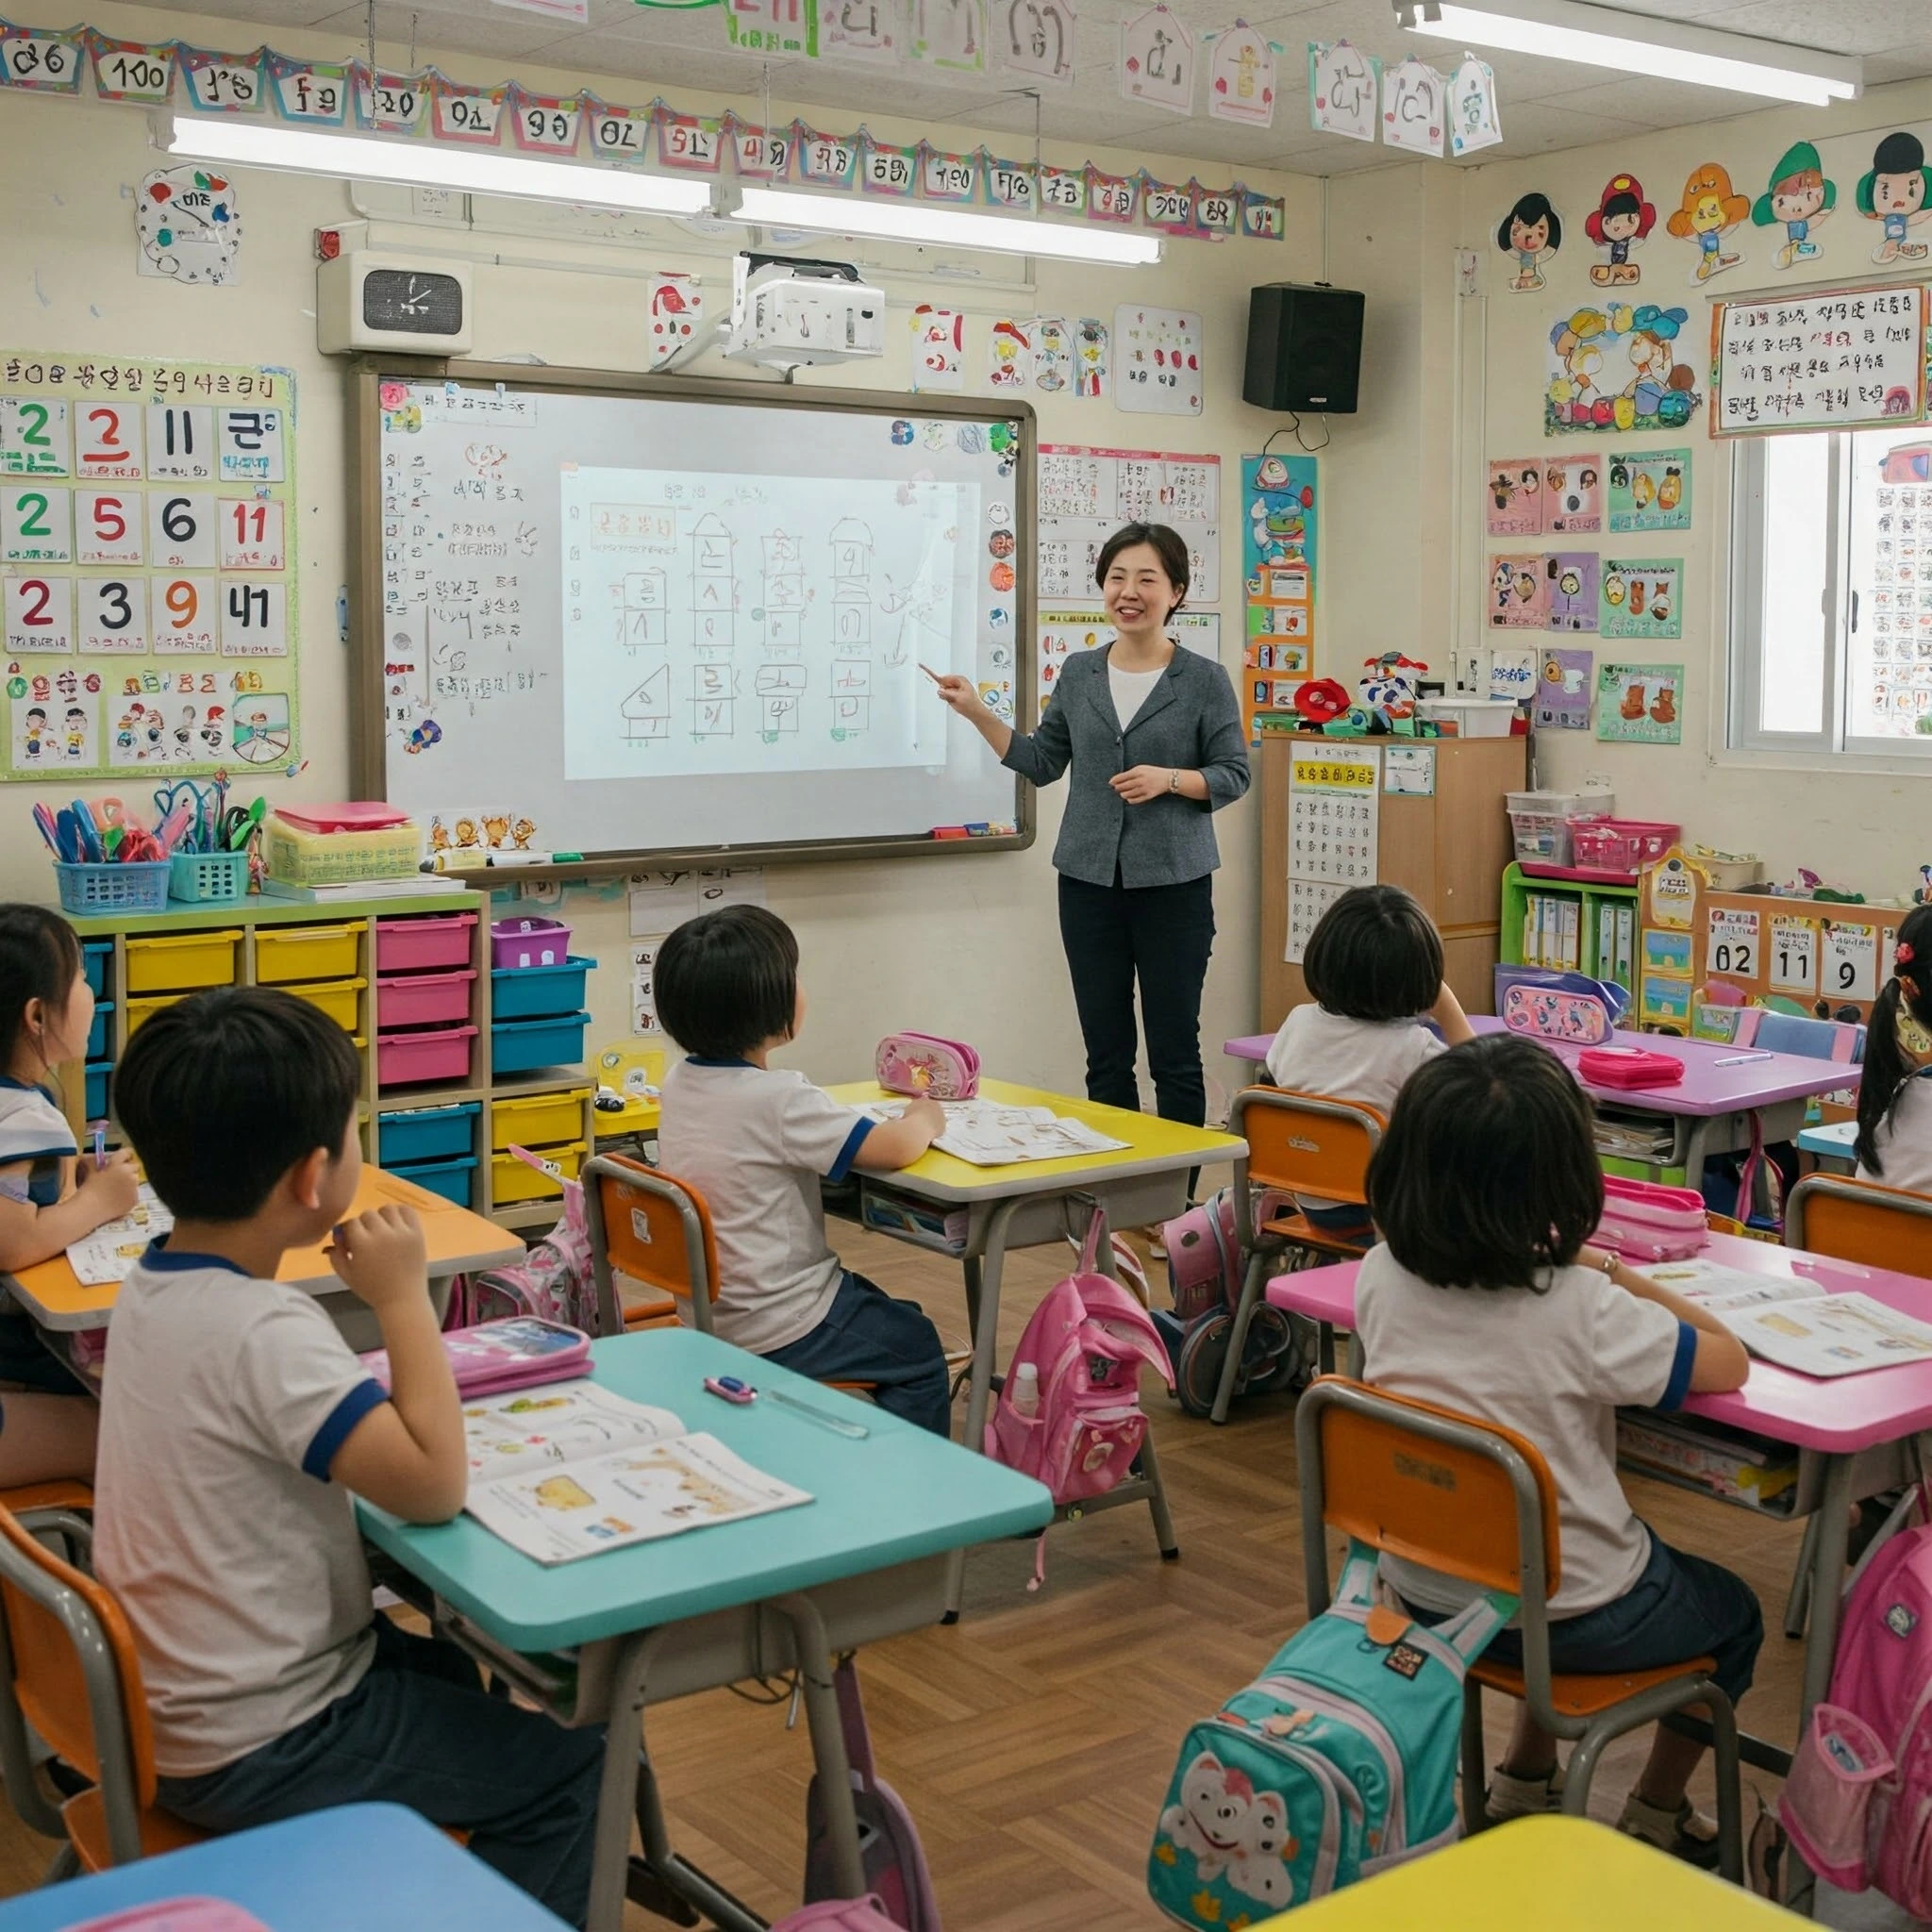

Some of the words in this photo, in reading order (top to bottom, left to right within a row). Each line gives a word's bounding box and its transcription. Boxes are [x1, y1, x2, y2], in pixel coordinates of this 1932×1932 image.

[112, 58, 164, 89] 100
[19, 404, 50, 445] 2
[89, 409, 119, 446] 2
[17, 493, 51, 536] 2
[94, 498, 125, 541] 5
[162, 498, 196, 541] 6
[234, 504, 265, 544] 11
[20, 580, 53, 625] 2
[100, 583, 131, 629] 3
[166, 581, 197, 628] 9
[1716, 945, 1750, 973] 02
[1779, 952, 1807, 978] 11
[1839, 961, 1856, 990] 9
